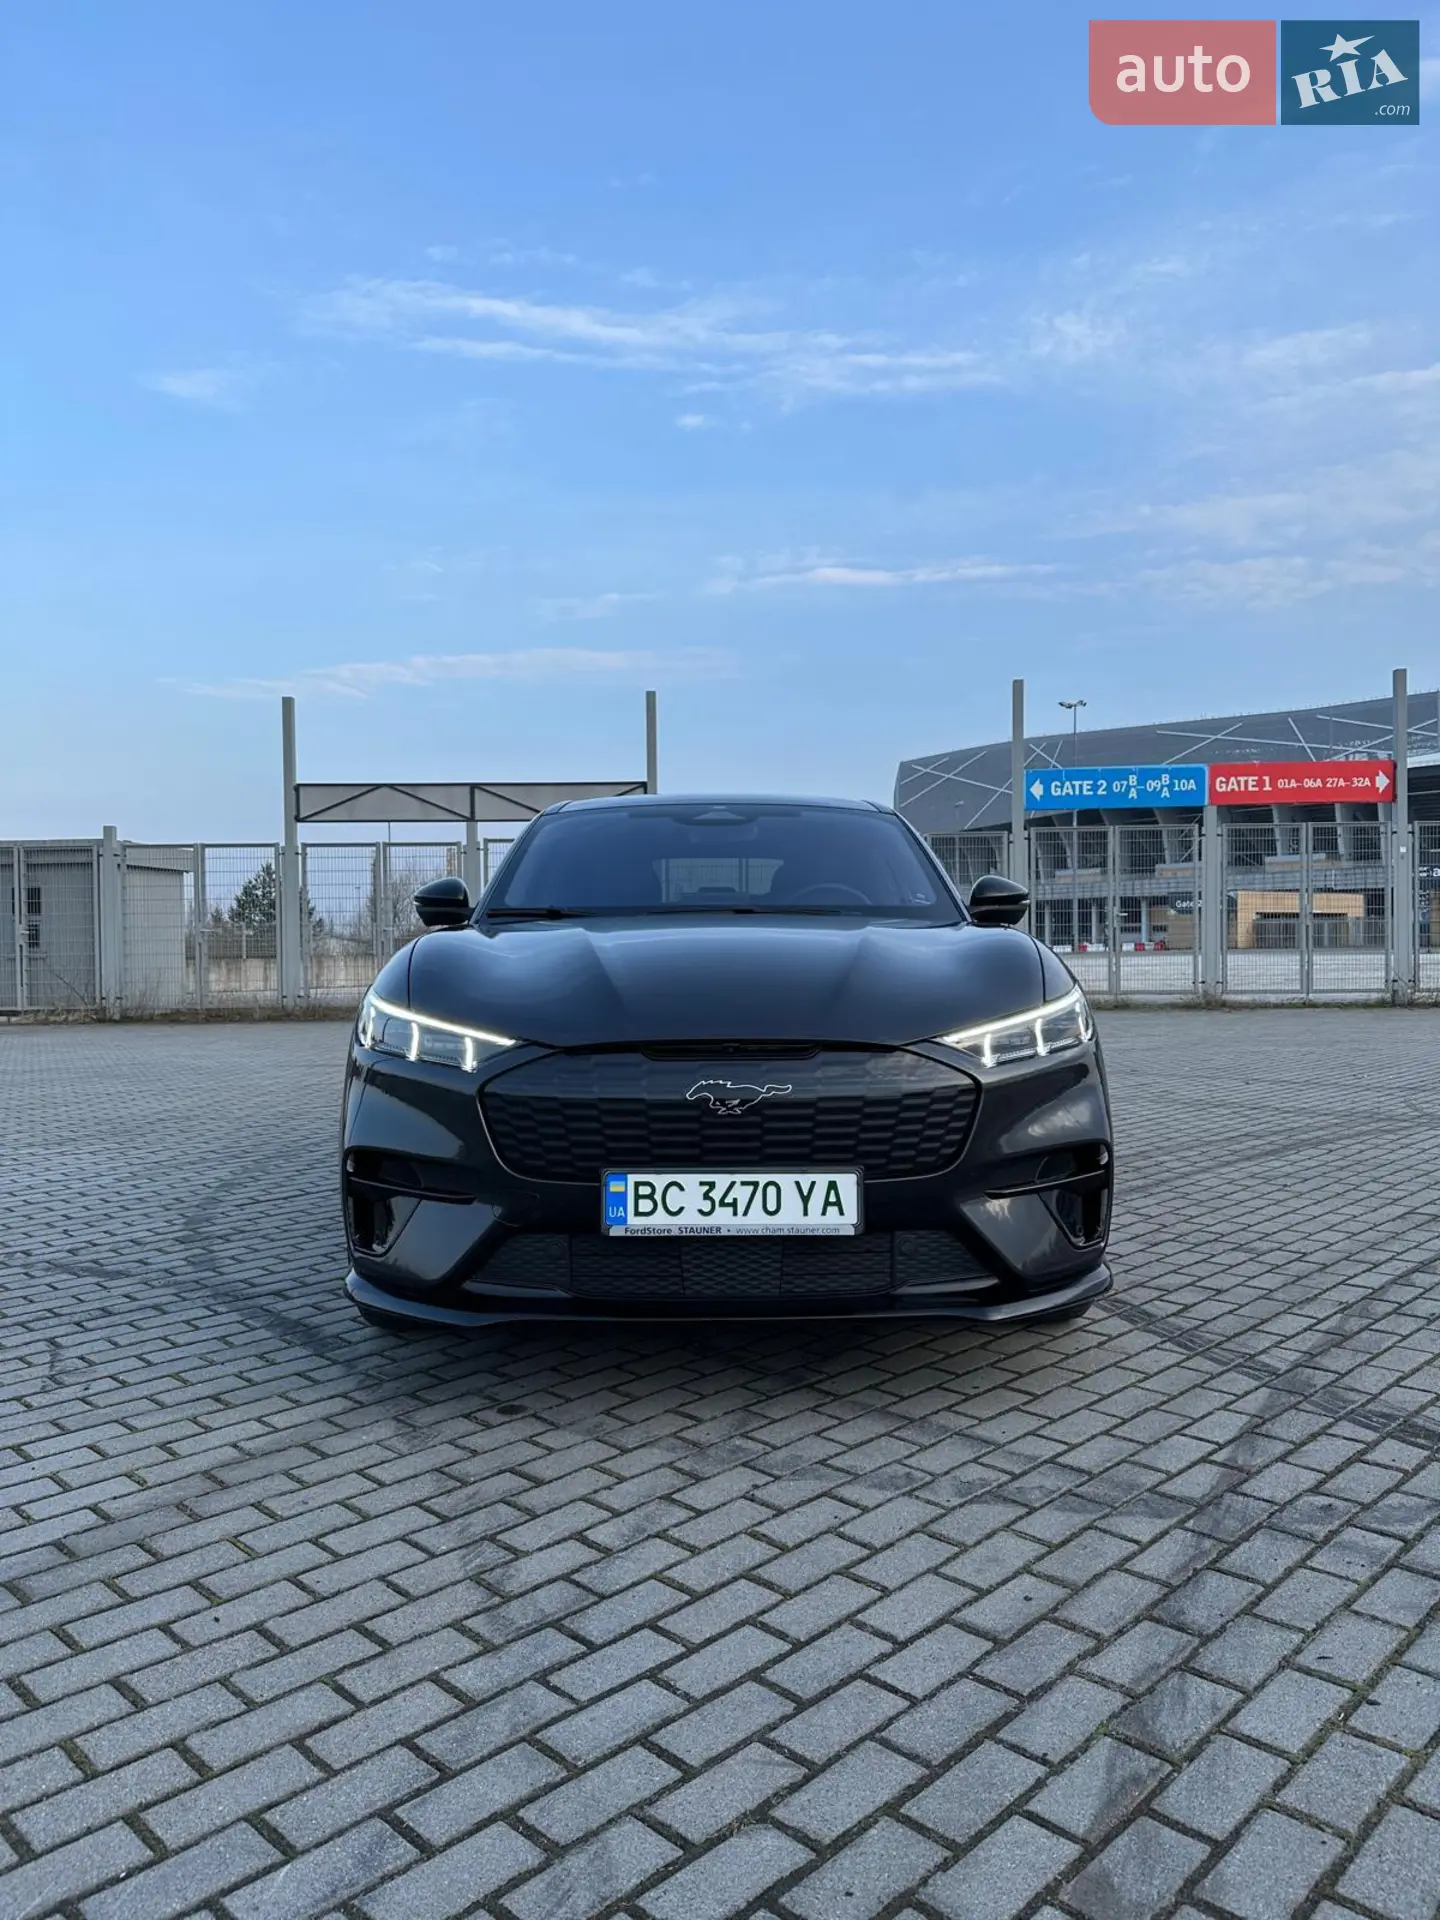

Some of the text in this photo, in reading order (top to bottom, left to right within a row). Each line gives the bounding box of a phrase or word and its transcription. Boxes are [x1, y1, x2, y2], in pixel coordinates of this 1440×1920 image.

[1051, 780, 1094, 797] GATE
[1097, 779, 1107, 795] 2
[1173, 779, 1197, 791] 10A
[1215, 775, 1259, 793] GATE
[1263, 775, 1273, 791] 1
[633, 1180, 845, 1217] BC 3470 YA
[609, 1206, 625, 1218] UA
[624, 1226, 673, 1235] FordStore
[677, 1226, 722, 1235] STAUNER
